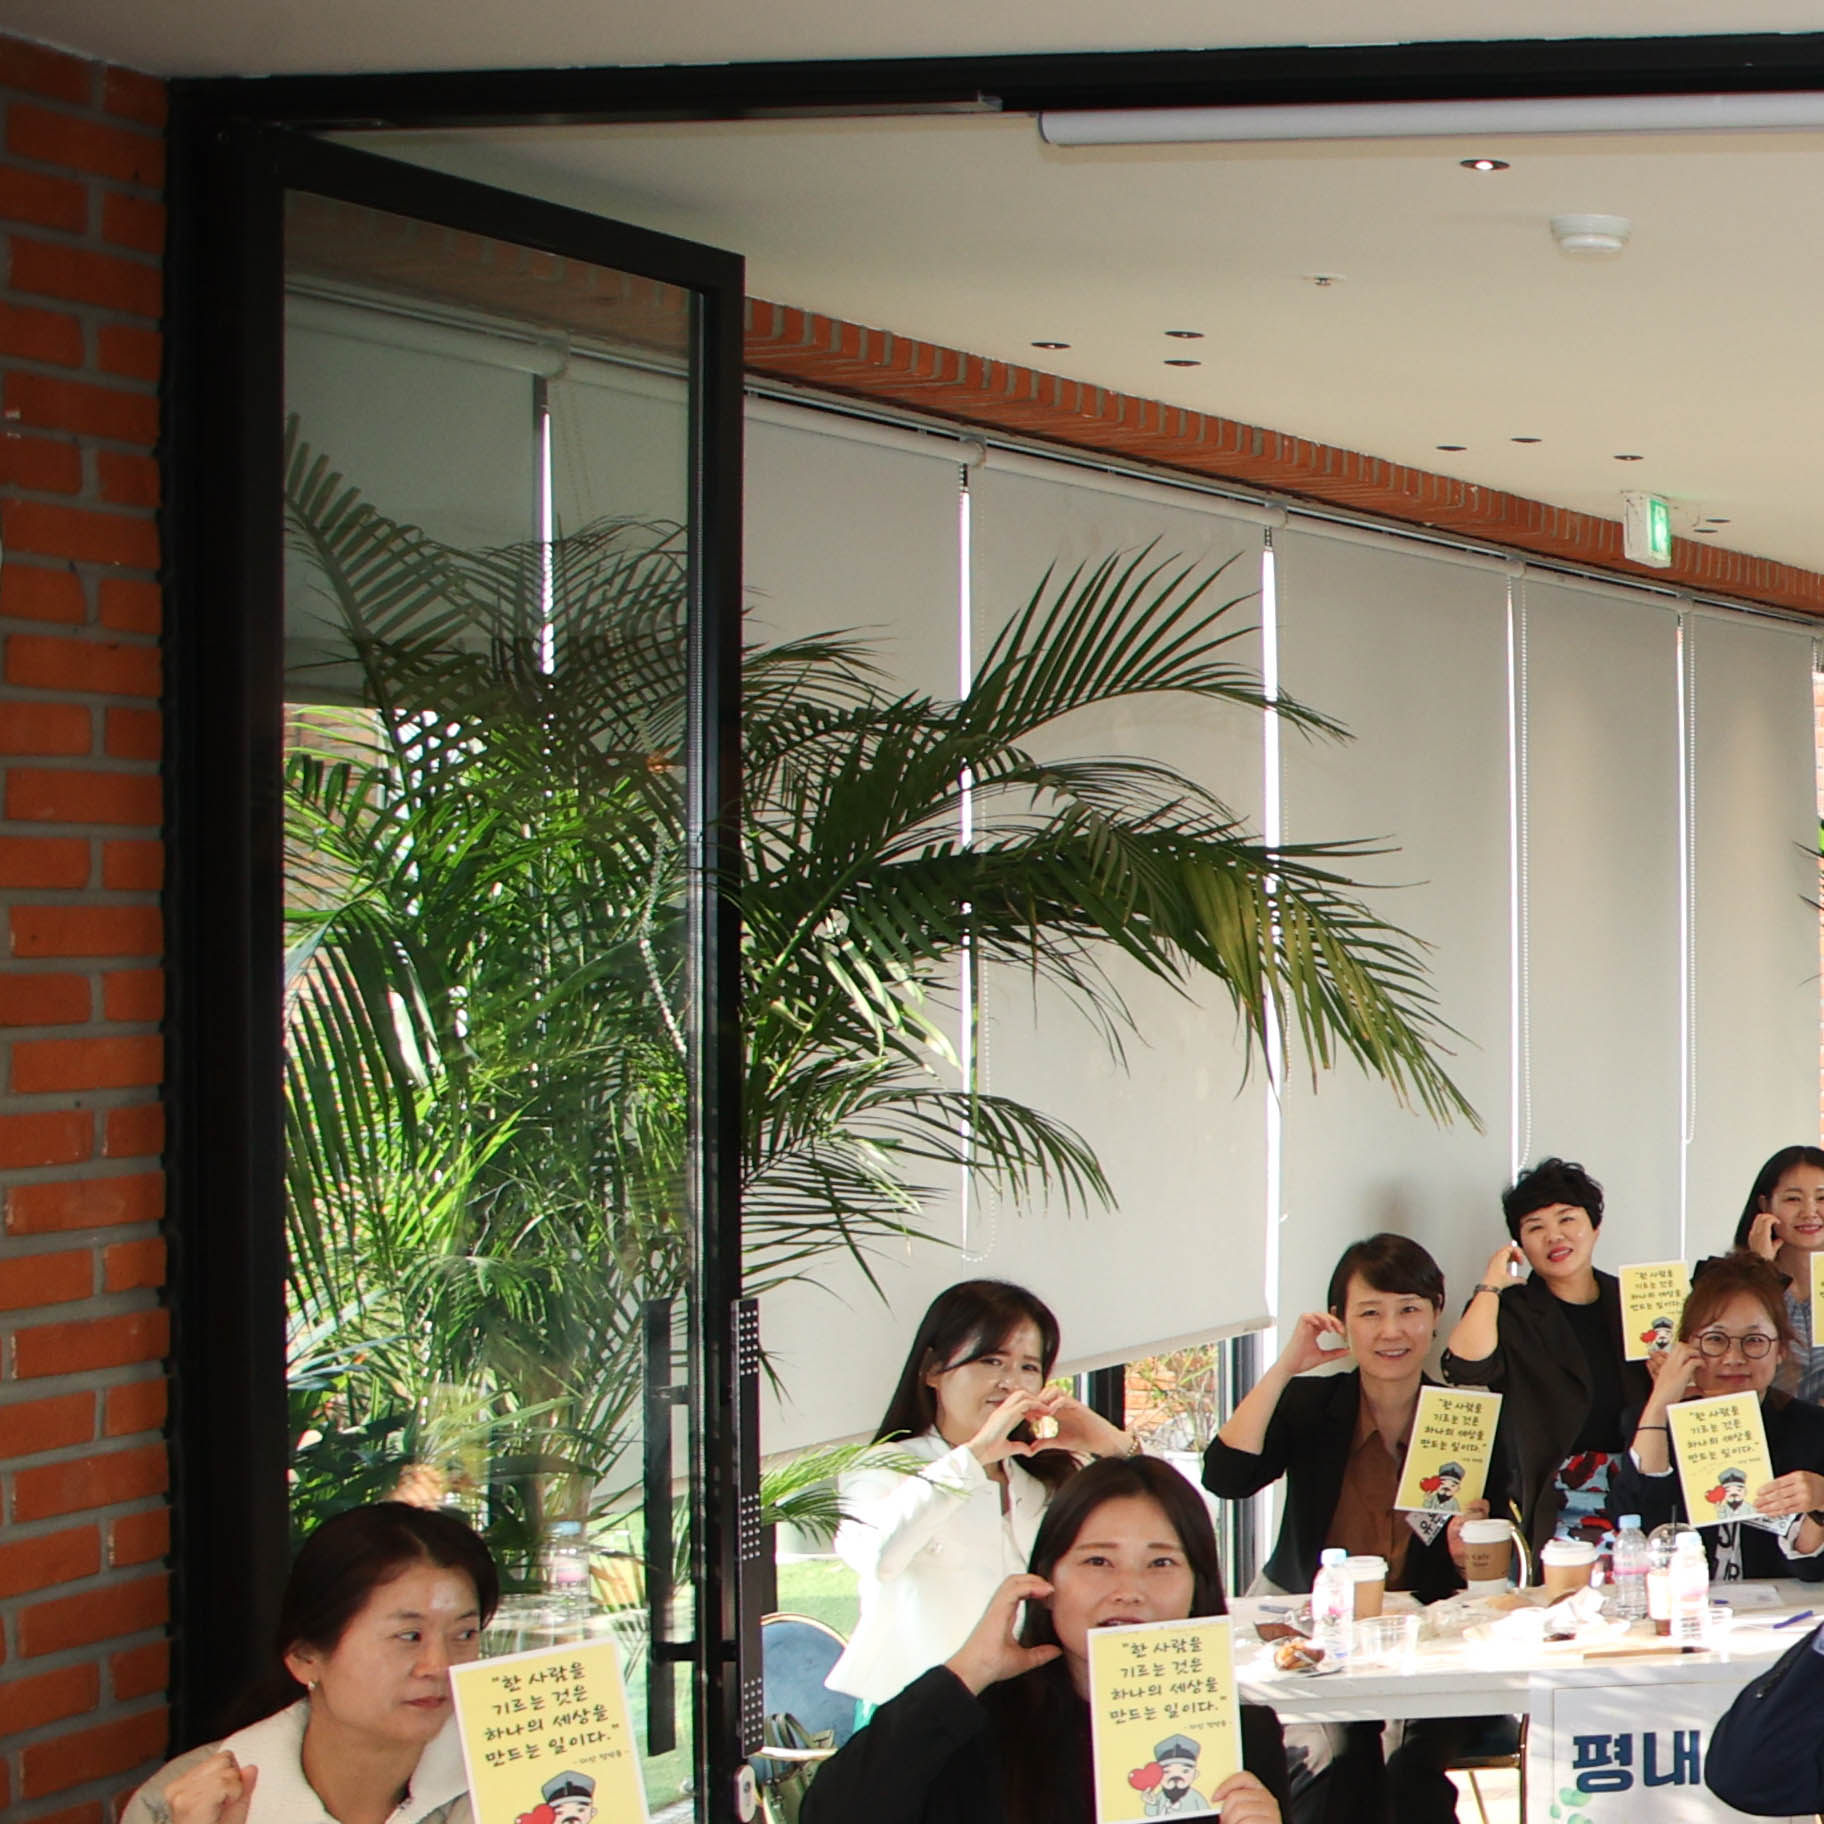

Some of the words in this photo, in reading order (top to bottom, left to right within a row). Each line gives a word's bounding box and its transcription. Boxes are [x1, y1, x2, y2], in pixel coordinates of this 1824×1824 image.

[1153, 1635, 1202, 1654] 사람을
[528, 1661, 585, 1685] 사람을
[1120, 1663, 1164, 1678] 기르는
[1171, 1657, 1202, 1675] 것은
[492, 1695, 545, 1715] 기르는
[551, 1685, 587, 1706] 것은
[1111, 1684, 1161, 1700] 하나의
[1169, 1676, 1218, 1694] 세상을
[484, 1718, 544, 1741] 하나의
[552, 1703, 608, 1727] 세상을
[1109, 1706, 1156, 1724] 만드는
[484, 1743, 540, 1767] 만드는
[1572, 1729, 1701, 1795] 평내
